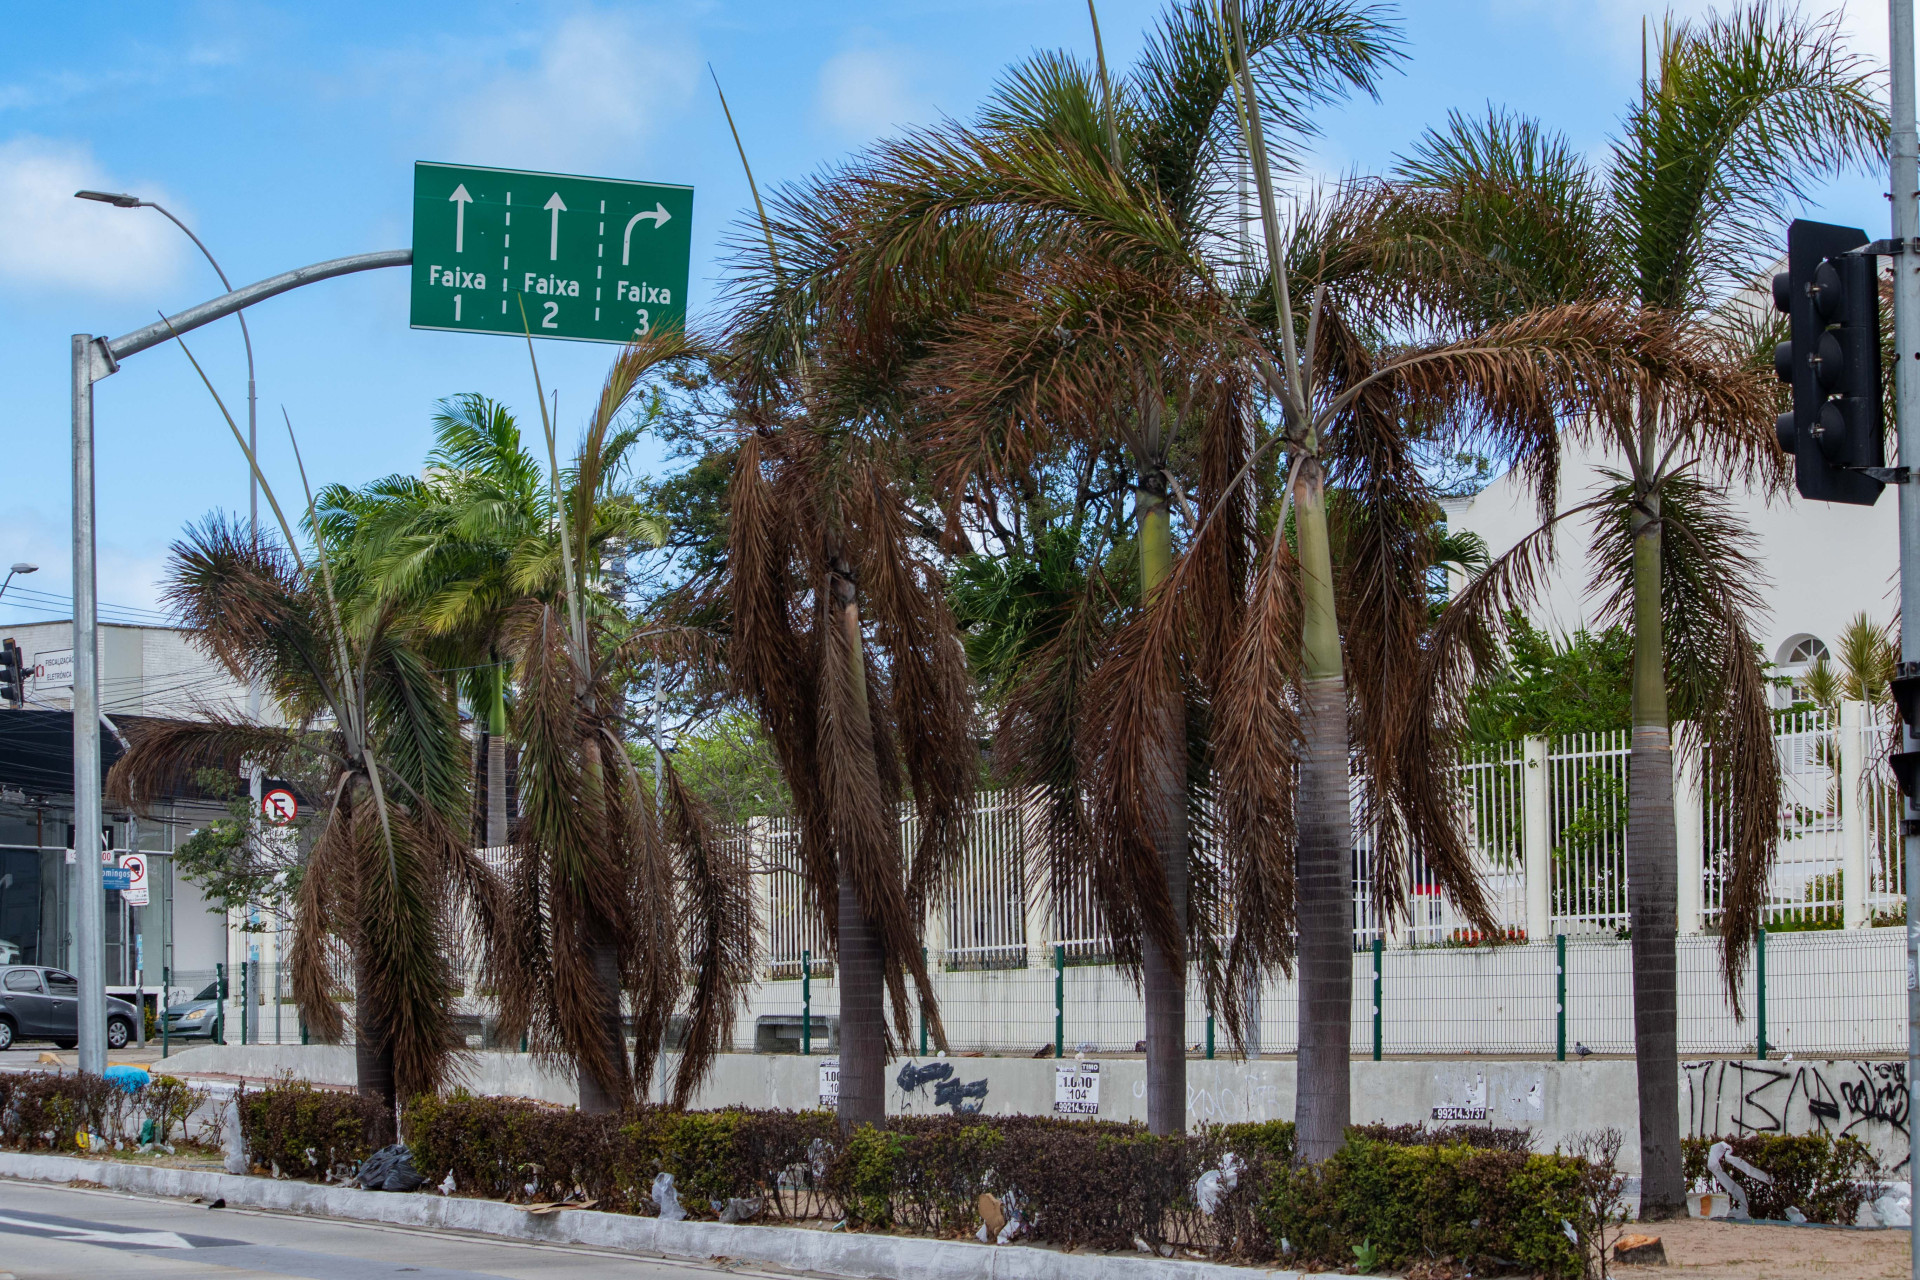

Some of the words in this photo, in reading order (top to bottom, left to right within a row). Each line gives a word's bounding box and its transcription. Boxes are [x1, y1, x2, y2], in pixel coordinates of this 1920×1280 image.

[429, 265, 486, 290] Faixa
[524, 272, 580, 297] Faixa
[617, 280, 671, 304] Faixa
[454, 294, 462, 321] 1
[541, 301, 559, 328] 2
[634, 309, 650, 336] 3
[102, 869, 130, 880] omingos
[1070, 1089, 1087, 1100] 104
[1437, 1108, 1485, 1119] 99214.3737
